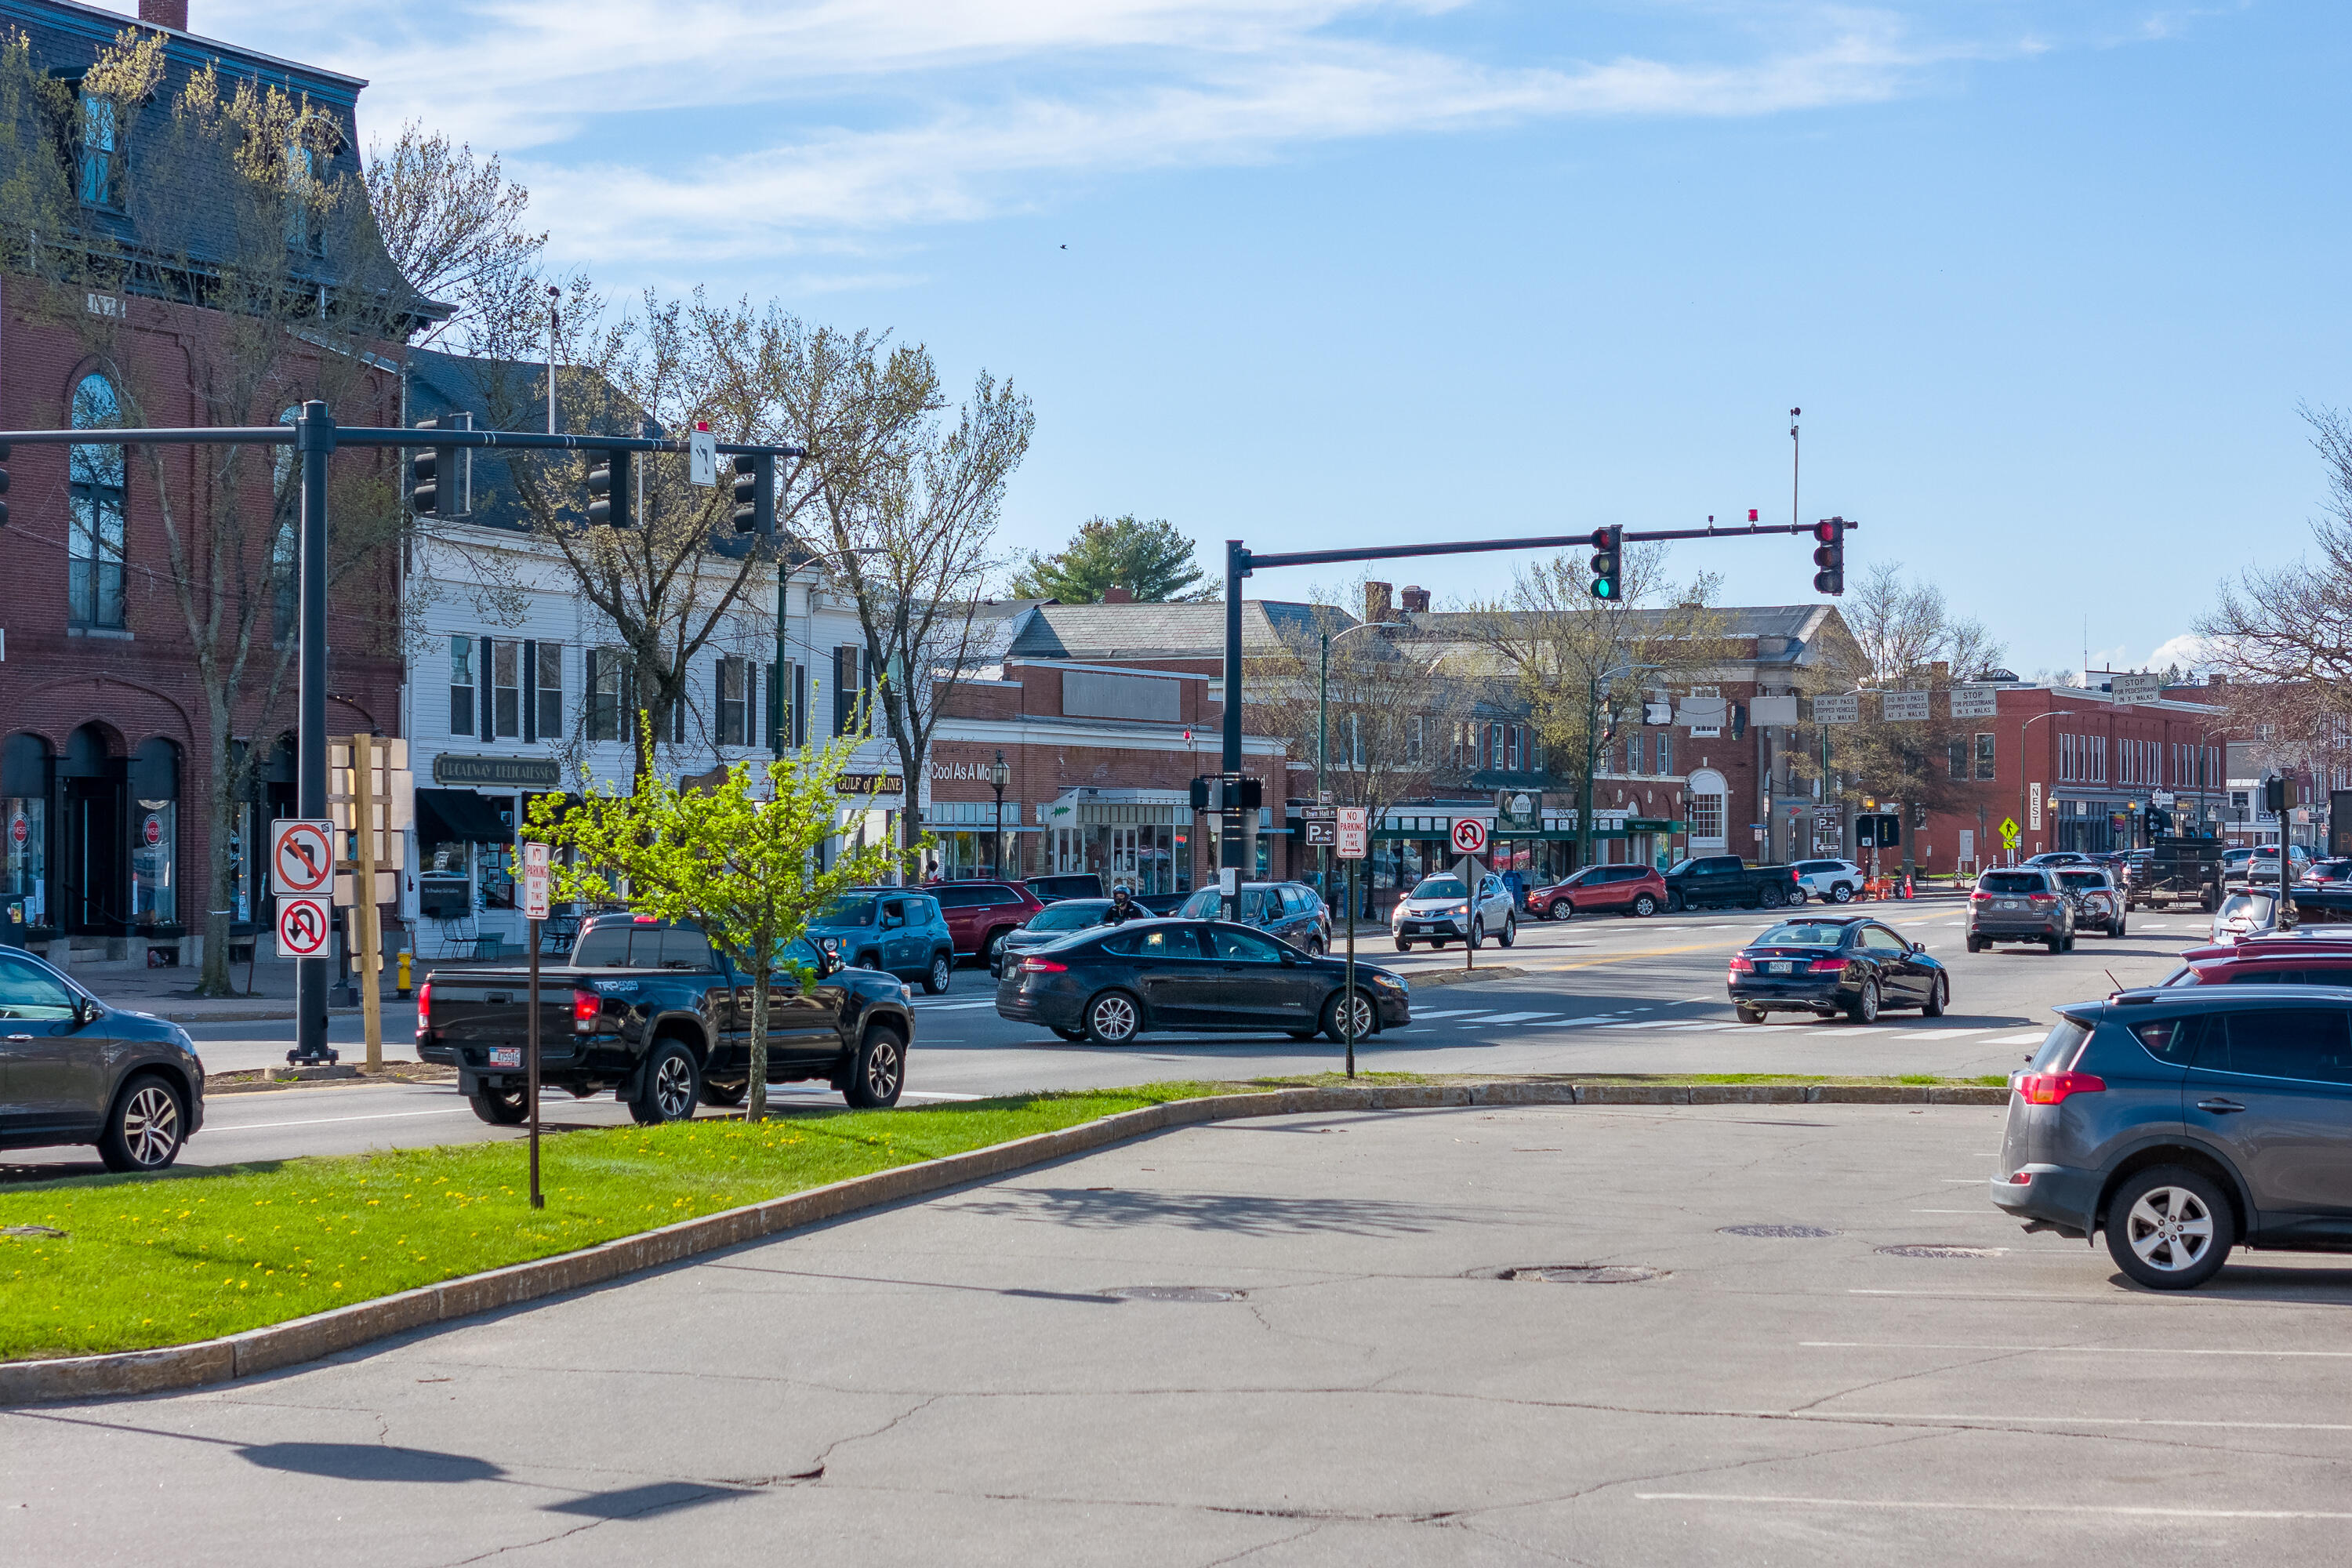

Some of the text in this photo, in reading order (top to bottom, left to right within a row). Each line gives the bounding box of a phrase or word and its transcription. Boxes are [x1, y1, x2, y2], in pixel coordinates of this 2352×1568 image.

[2125, 678, 2145, 687] STOP
[1963, 691, 1983, 699] STOP
[2125, 685, 2157, 695] PEDESTRIANS
[1962, 699, 1995, 707] PEDESTRIANS
[442, 762, 556, 779] BROADWAY DELICATESSEN
[931, 761, 953, 779] Cool
[953, 761, 967, 780] As
[967, 762, 975, 780] A
[838, 777, 862, 790] GULF
[863, 777, 872, 793] of
[1346, 811, 1357, 820] NO
[1340, 822, 1363, 831] PARKING
[532, 848, 542, 862] NO
[527, 864, 547, 878] PARKING
[532, 880, 542, 890] ANY
[531, 891, 543, 902] TIME
[594, 981, 619, 991] TRD
